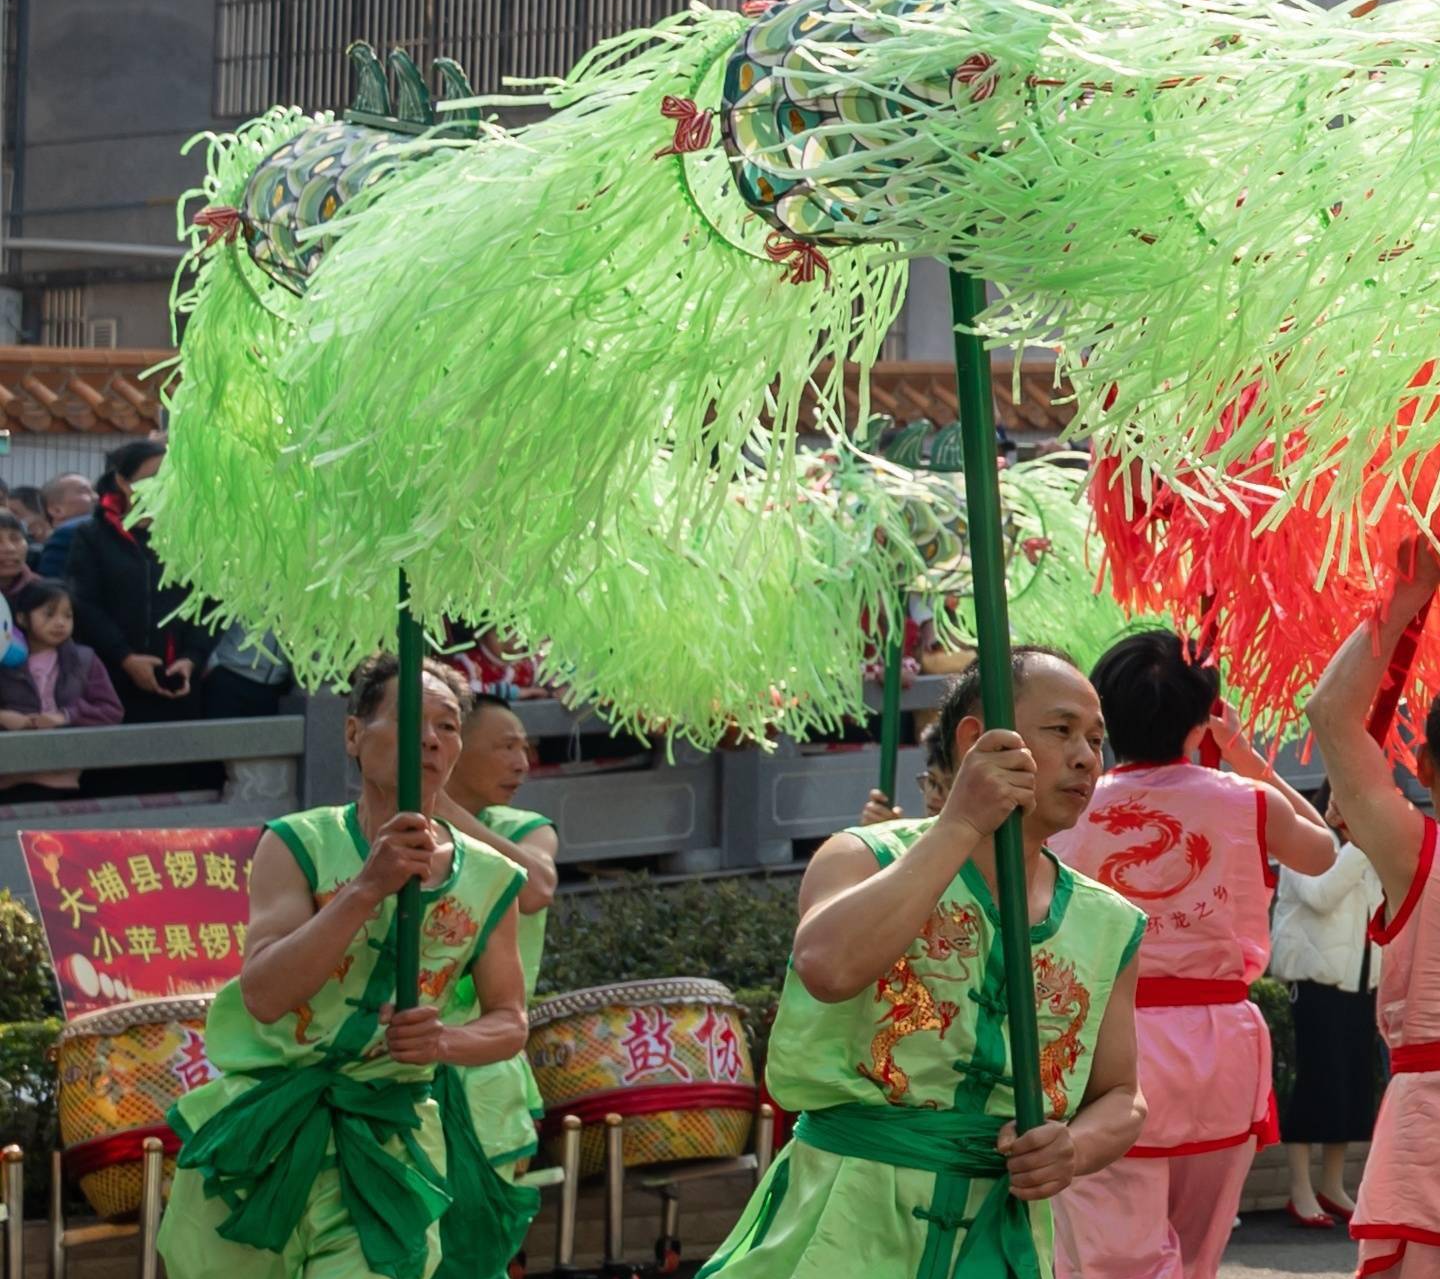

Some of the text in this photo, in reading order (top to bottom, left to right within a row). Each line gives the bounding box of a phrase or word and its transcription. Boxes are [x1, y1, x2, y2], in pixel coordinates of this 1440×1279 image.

[60, 850, 252, 929] 大埔县锣鼓
